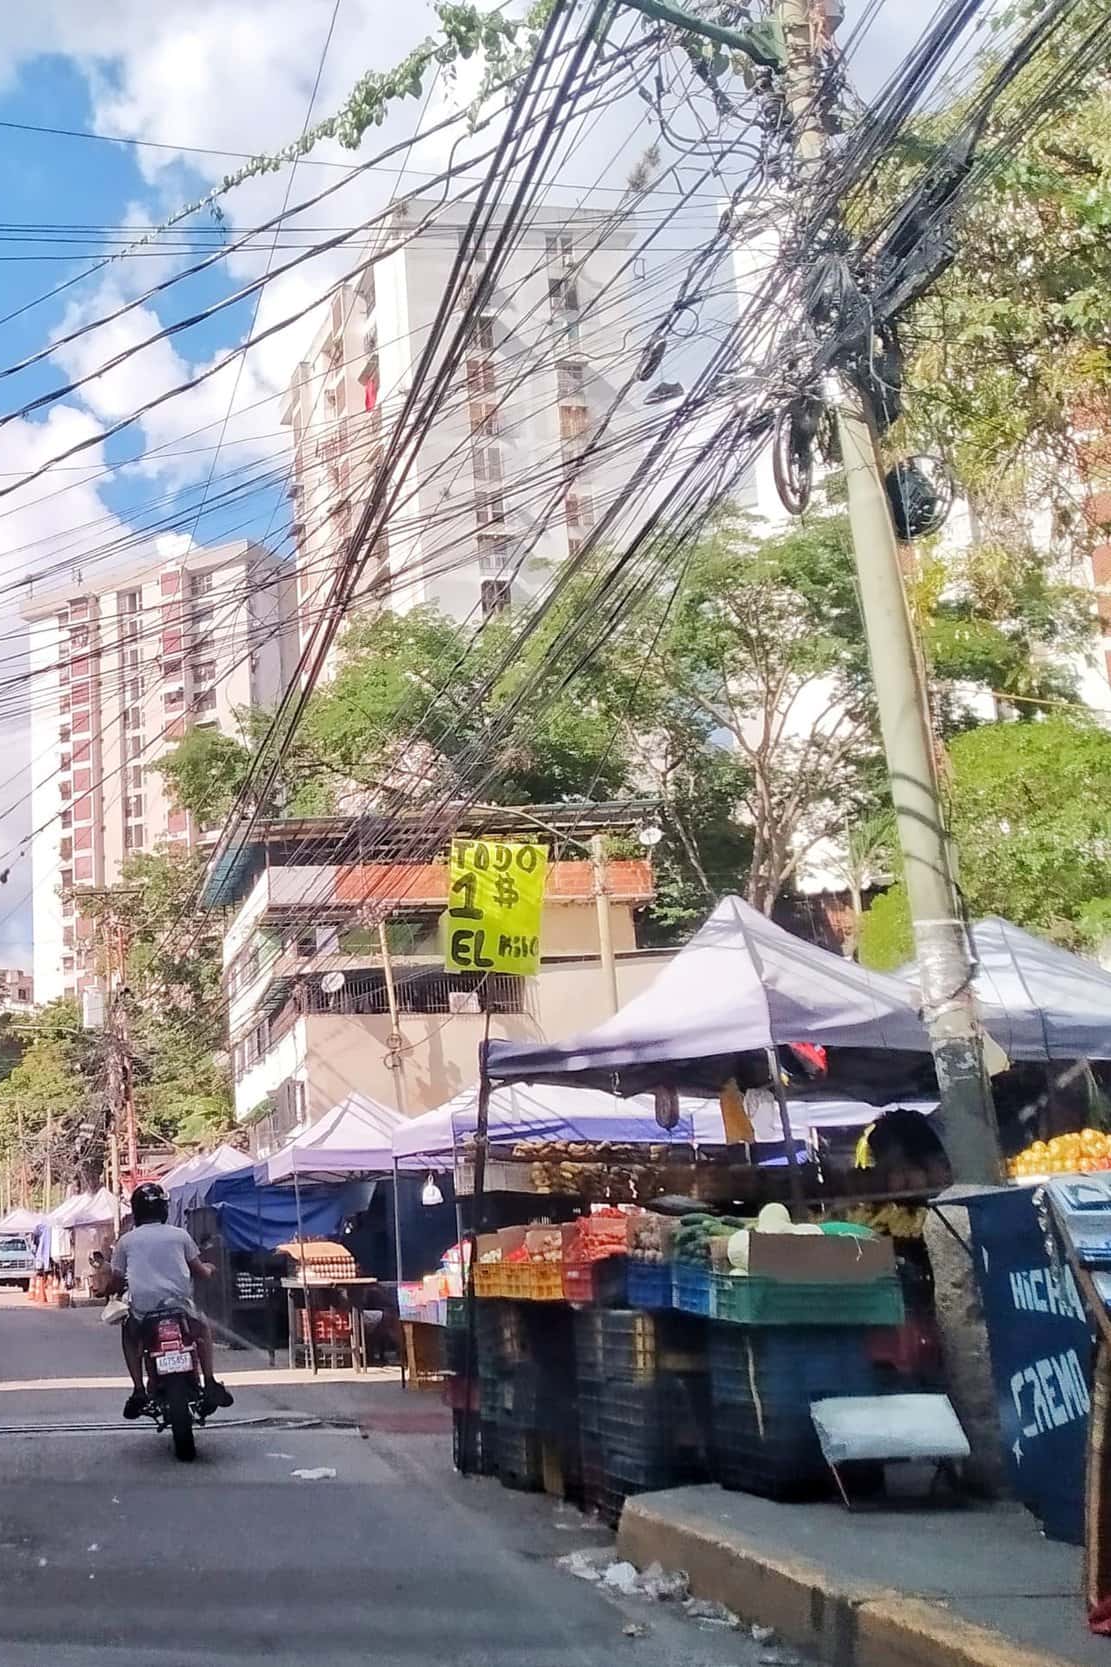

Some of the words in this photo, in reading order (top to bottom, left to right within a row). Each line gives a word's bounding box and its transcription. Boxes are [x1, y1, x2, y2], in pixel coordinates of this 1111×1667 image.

[453, 841, 537, 875] TODO
[449, 871, 484, 920] 1
[492, 871, 520, 910] $
[451, 929, 494, 968] EL
